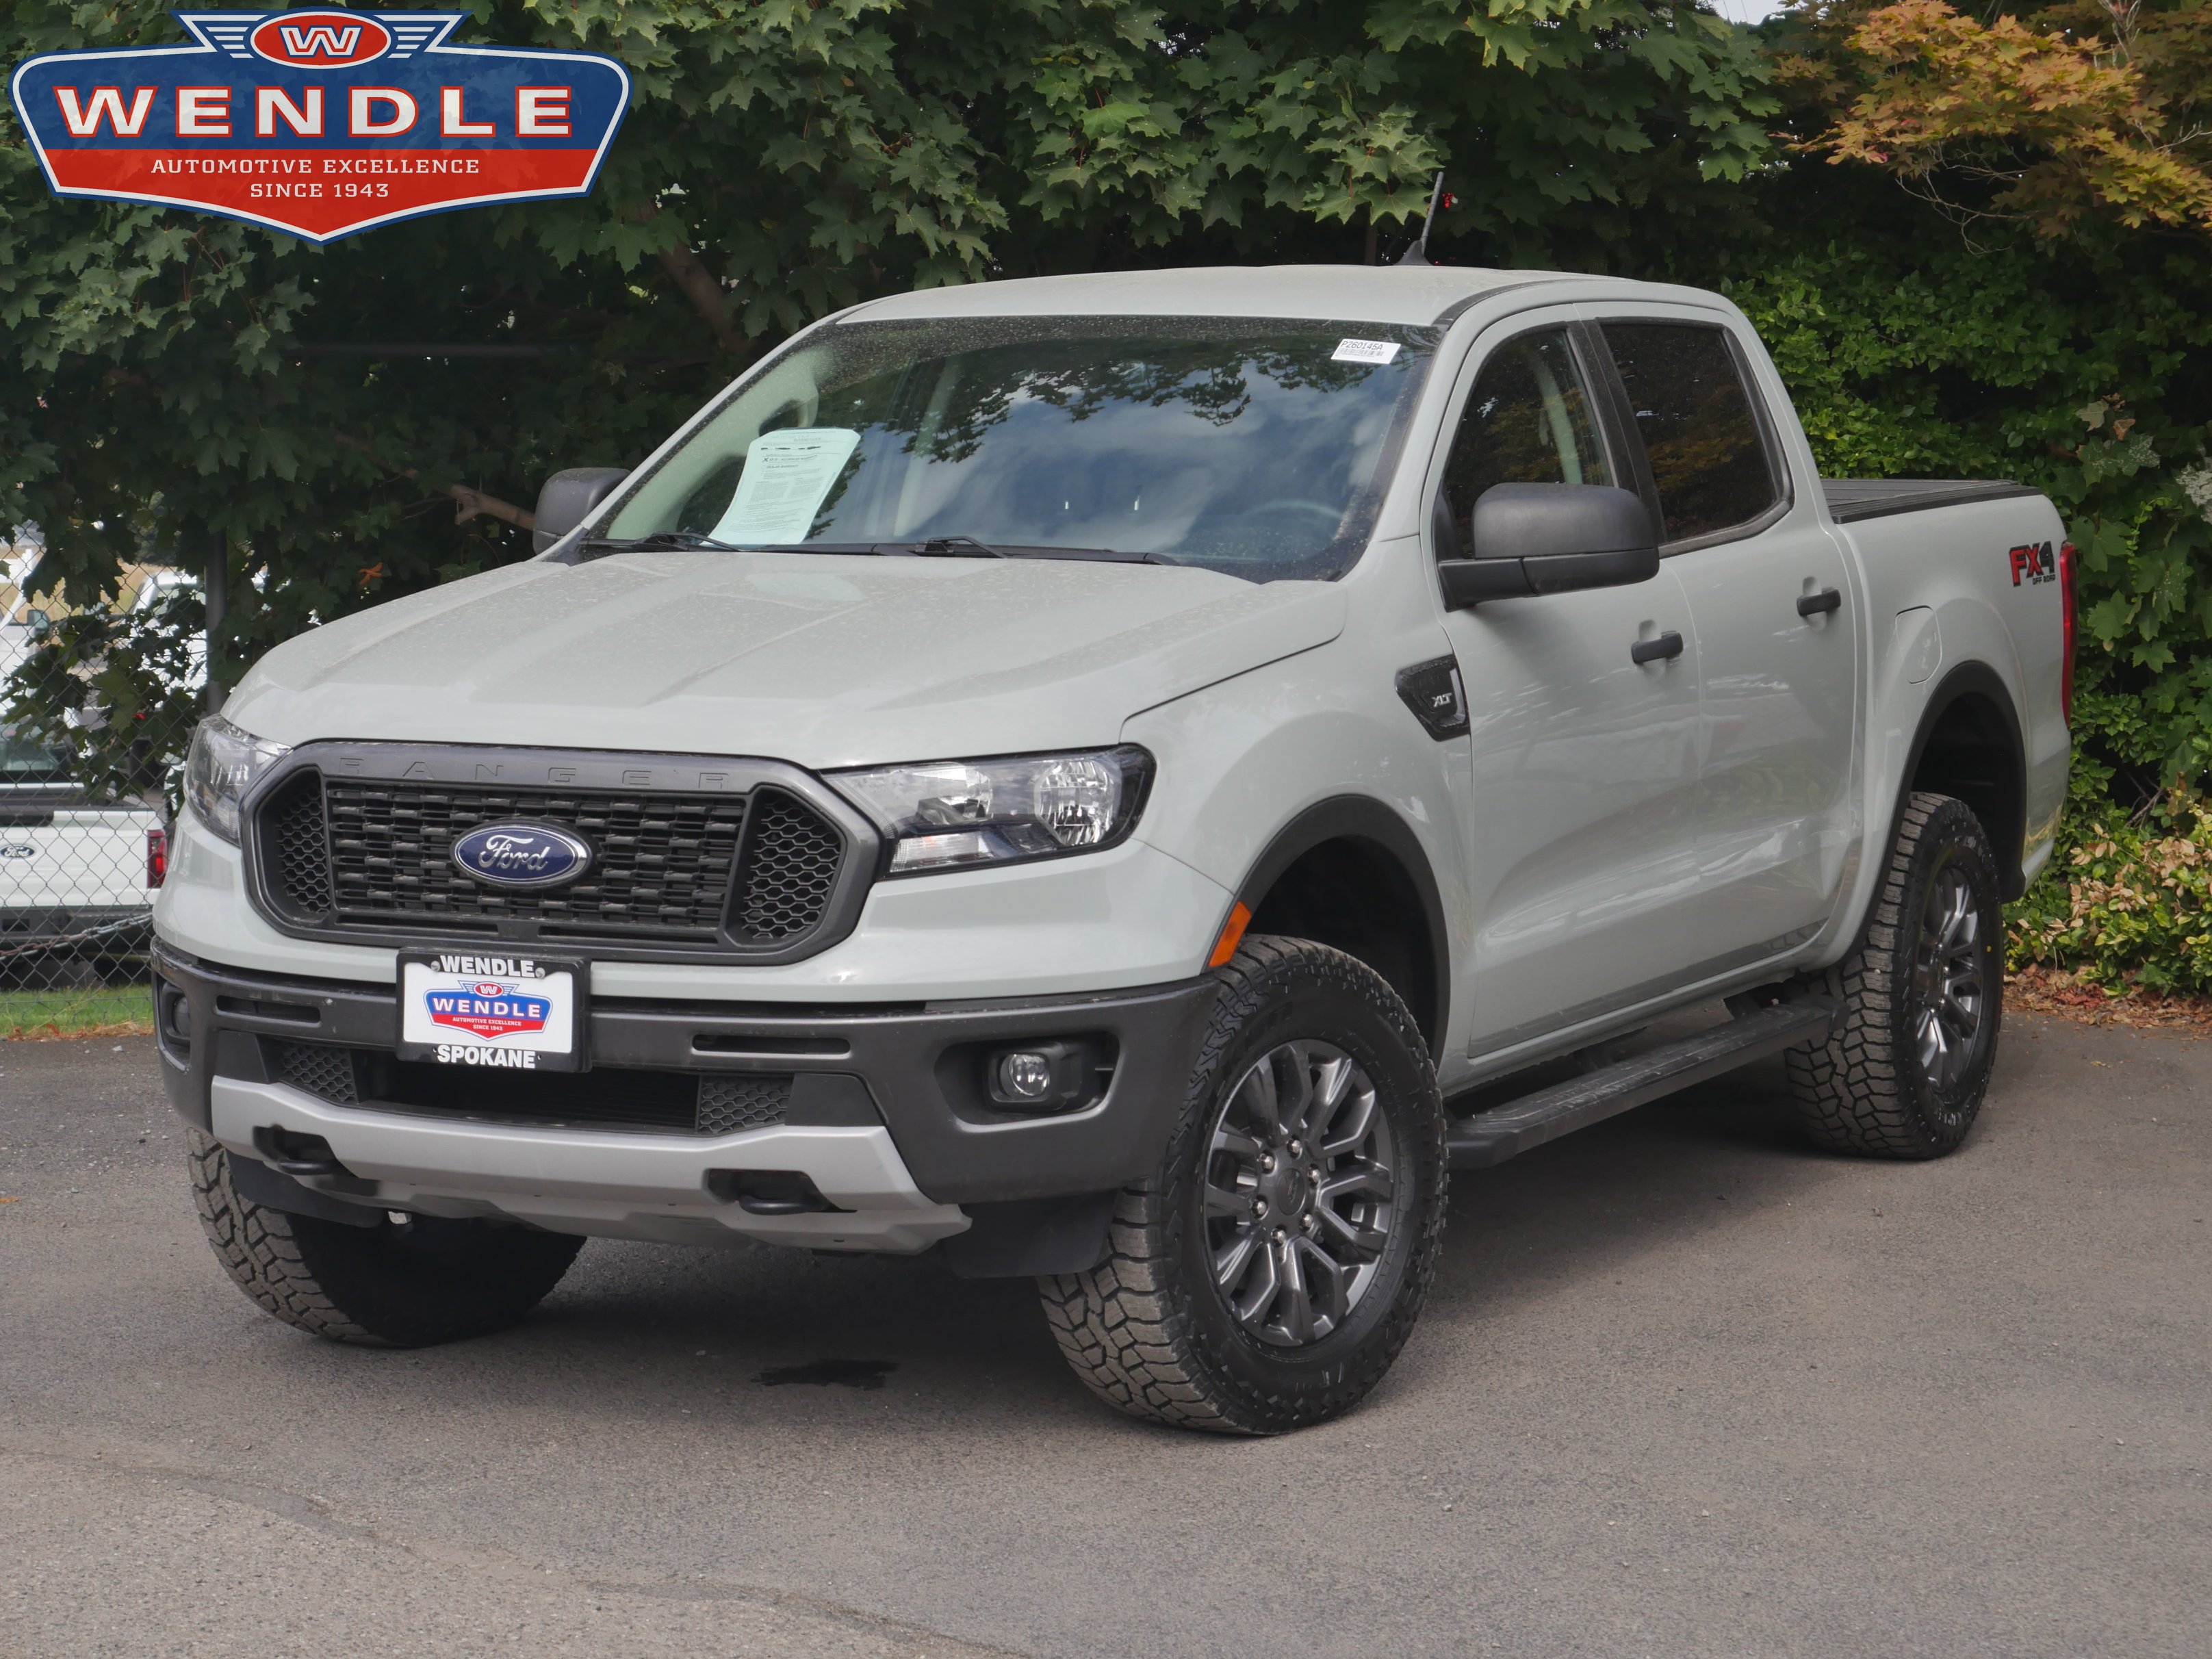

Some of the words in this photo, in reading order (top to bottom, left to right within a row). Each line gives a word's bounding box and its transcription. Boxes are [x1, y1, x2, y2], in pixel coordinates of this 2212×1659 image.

[1341, 341, 1383, 350] P260145A
[2009, 541, 2055, 587] FX4
[2033, 577, 2042, 585] OFF
[2044, 574, 2056, 583] ROAD
[1431, 693, 1452, 707] XLT
[339, 757, 730, 789] RANGER
[479, 834, 550, 871] Ford
[439, 955, 535, 978] WENDLE
[433, 997, 541, 1018] WENDLE
[452, 1016, 487, 1025] AUTOMOTIVE
[488, 1018, 522, 1027] EXCELLENCE
[437, 1044, 535, 1068] SPOKANE
